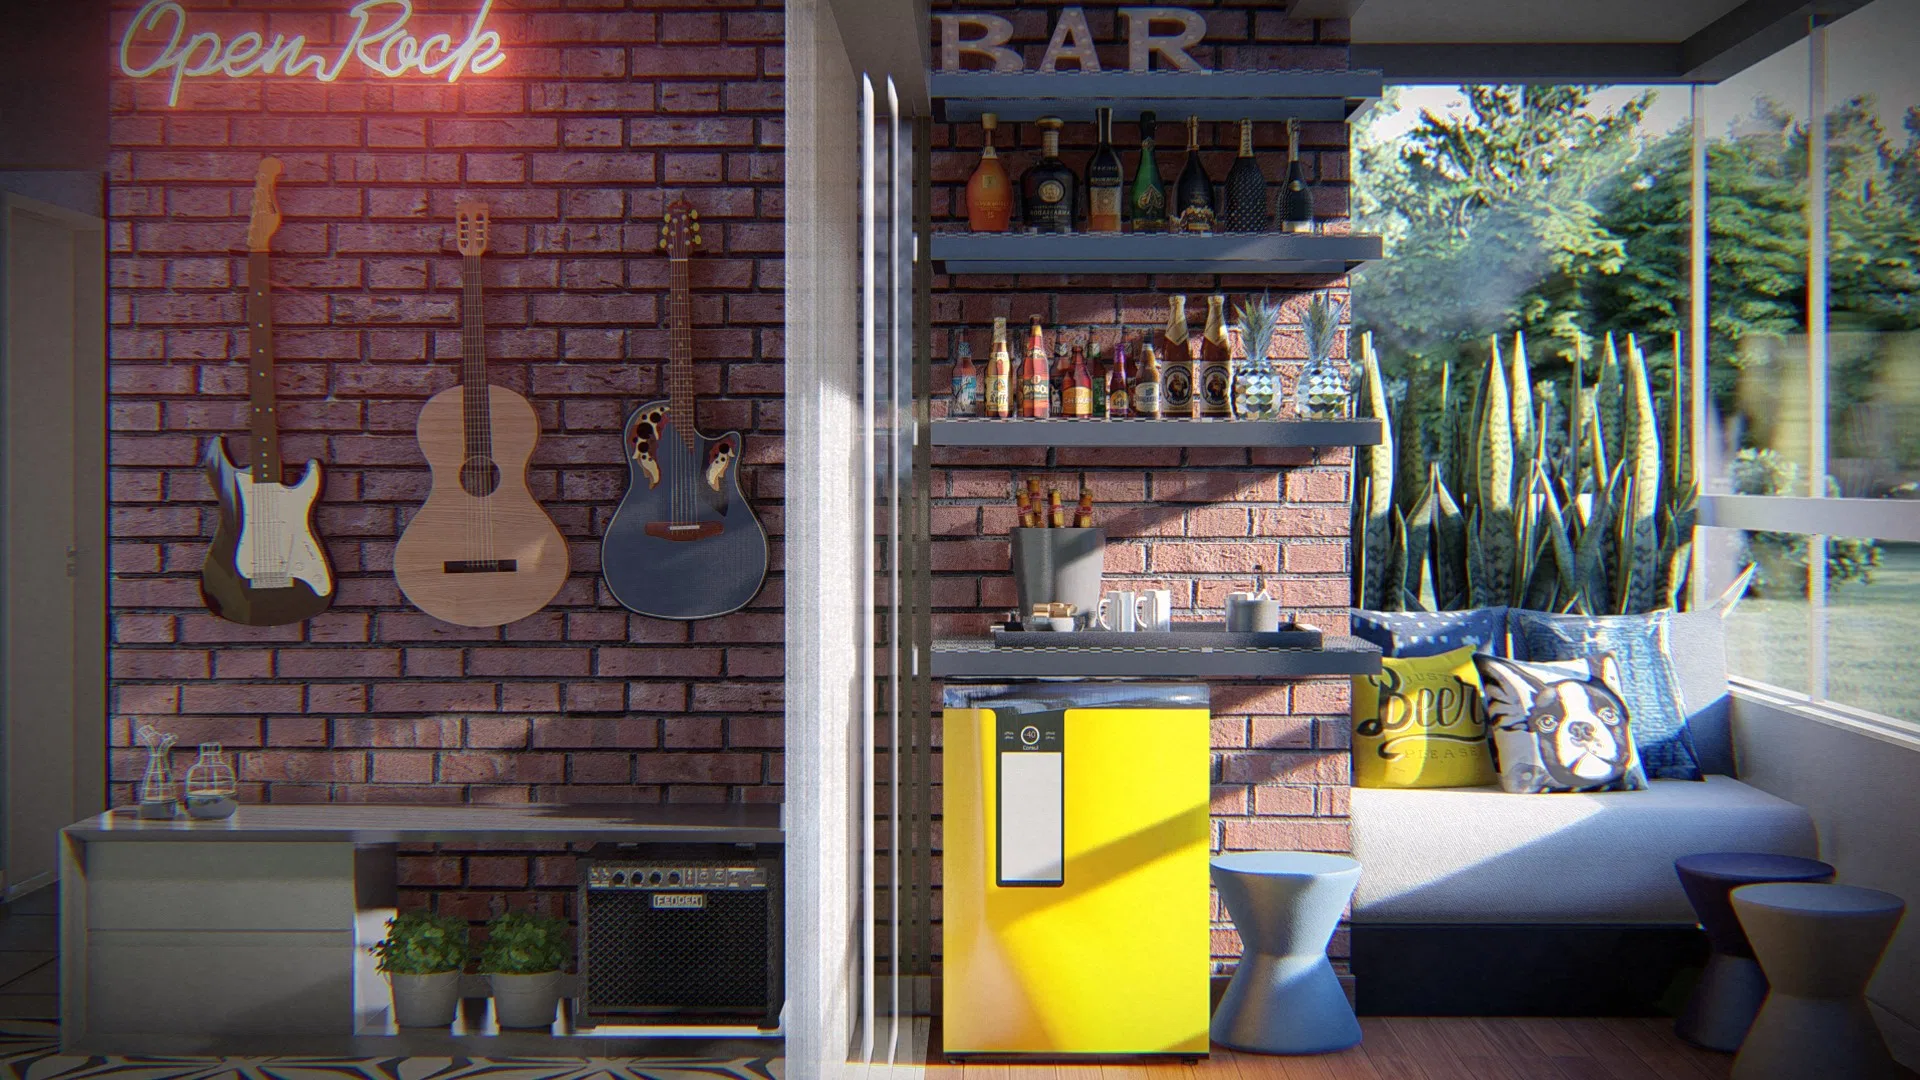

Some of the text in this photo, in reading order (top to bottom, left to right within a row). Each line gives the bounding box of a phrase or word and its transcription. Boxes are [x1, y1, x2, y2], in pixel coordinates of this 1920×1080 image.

[120, 0, 506, 107] Open Rock
[934, 7, 1207, 72] BAR
[1357, 666, 1488, 740] Beer
[1406, 672, 1450, 684] JUST
[1405, 747, 1479, 760] PLEASE
